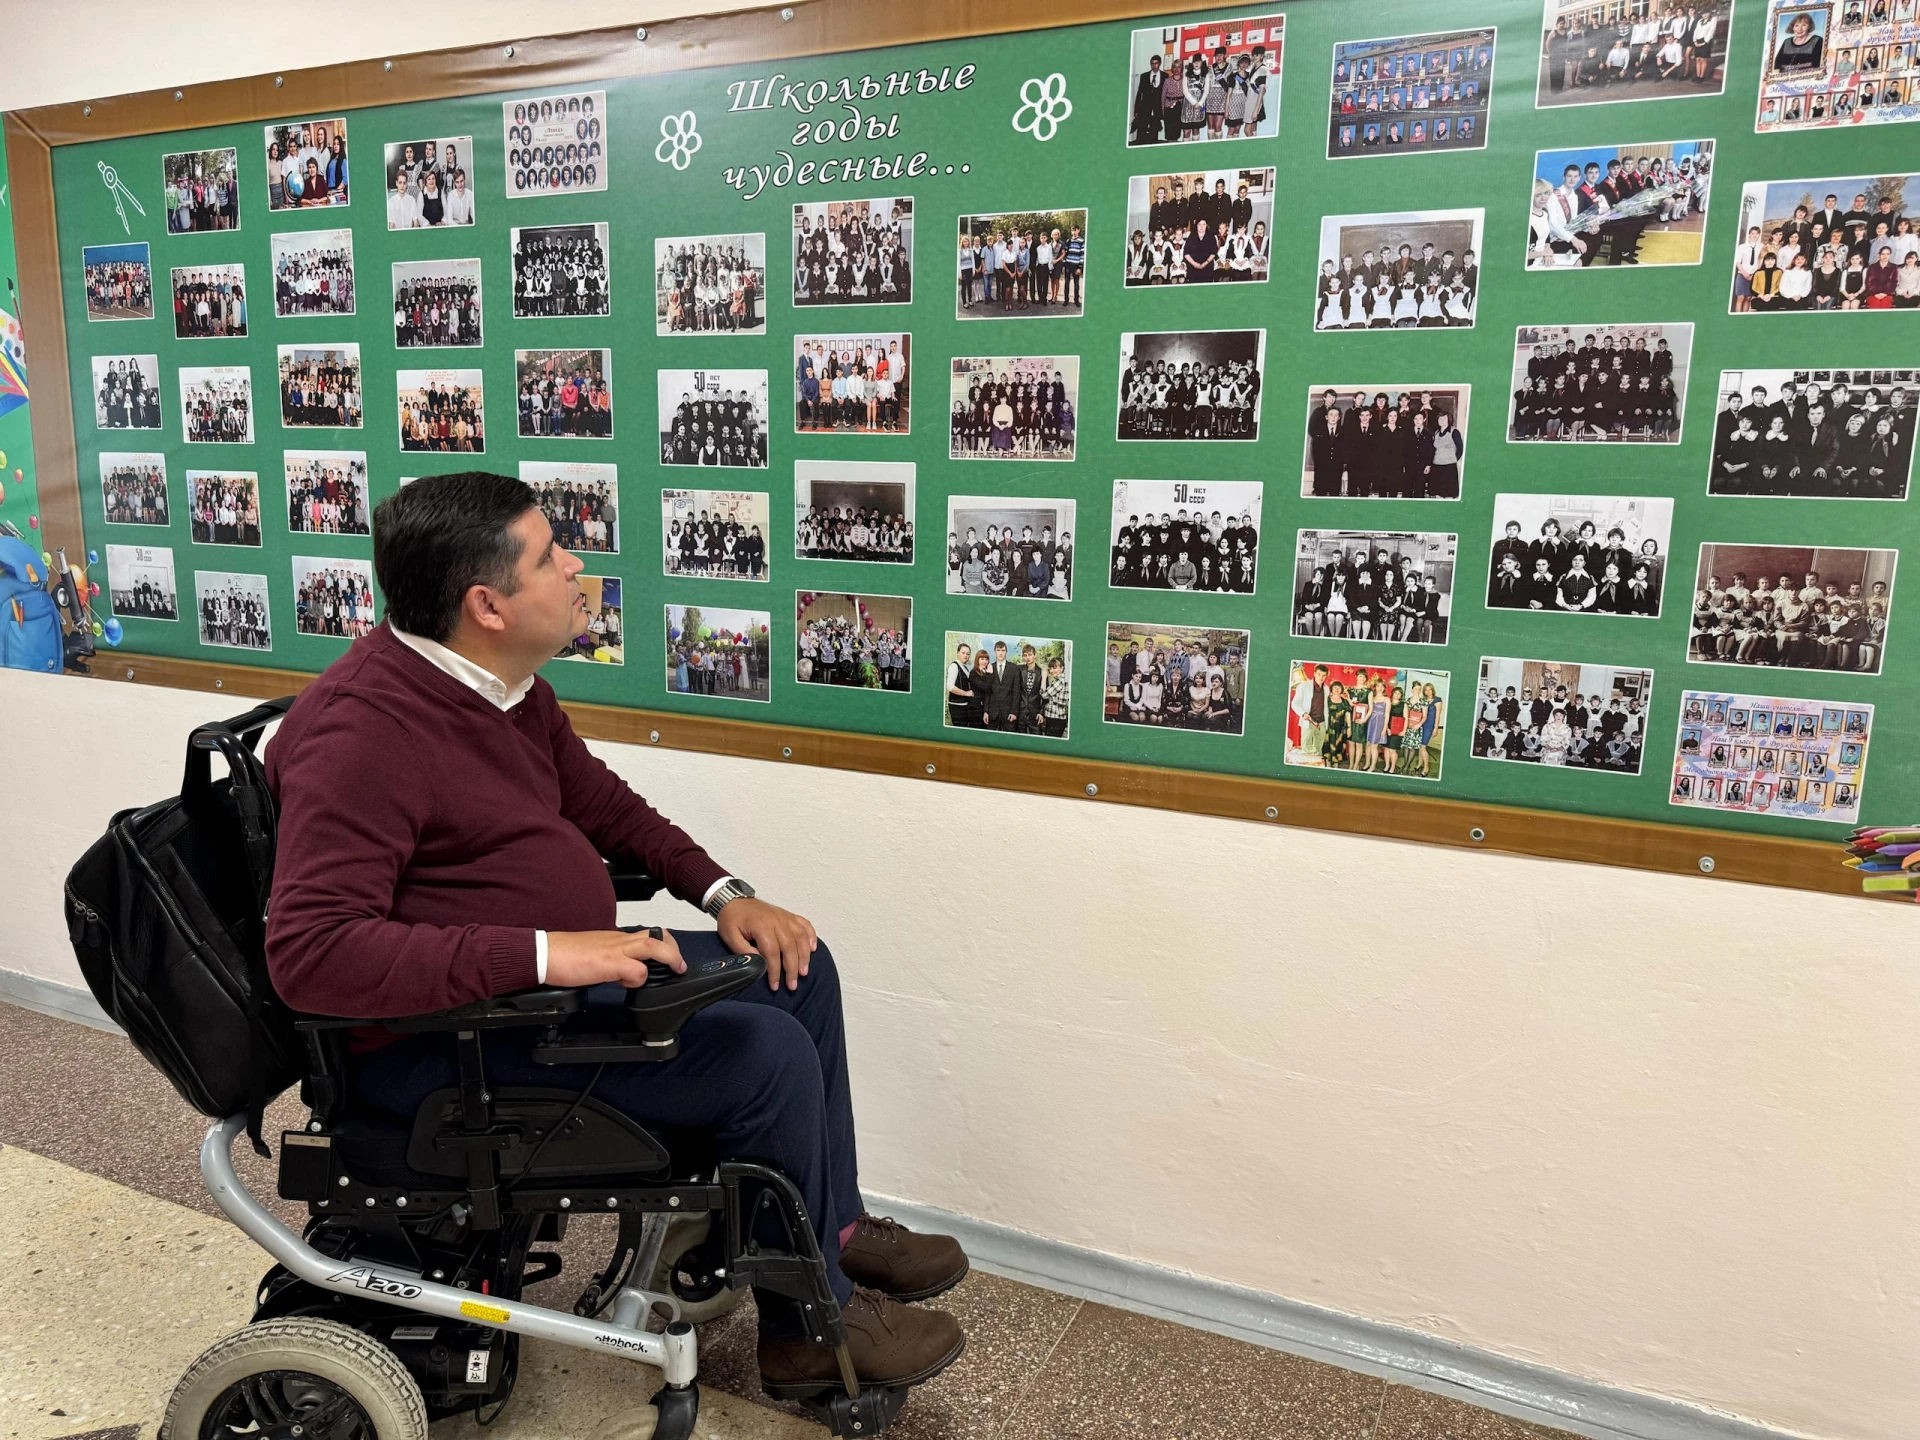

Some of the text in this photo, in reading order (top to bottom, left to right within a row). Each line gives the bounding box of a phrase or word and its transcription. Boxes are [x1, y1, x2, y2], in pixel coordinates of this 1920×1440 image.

[726, 62, 977, 114] Школьные
[790, 104, 901, 147] годы
[722, 150, 971, 201] чудесные...
[694, 371, 705, 390] 50
[1174, 483, 1188, 503] 50
[326, 1266, 423, 1299] A200
